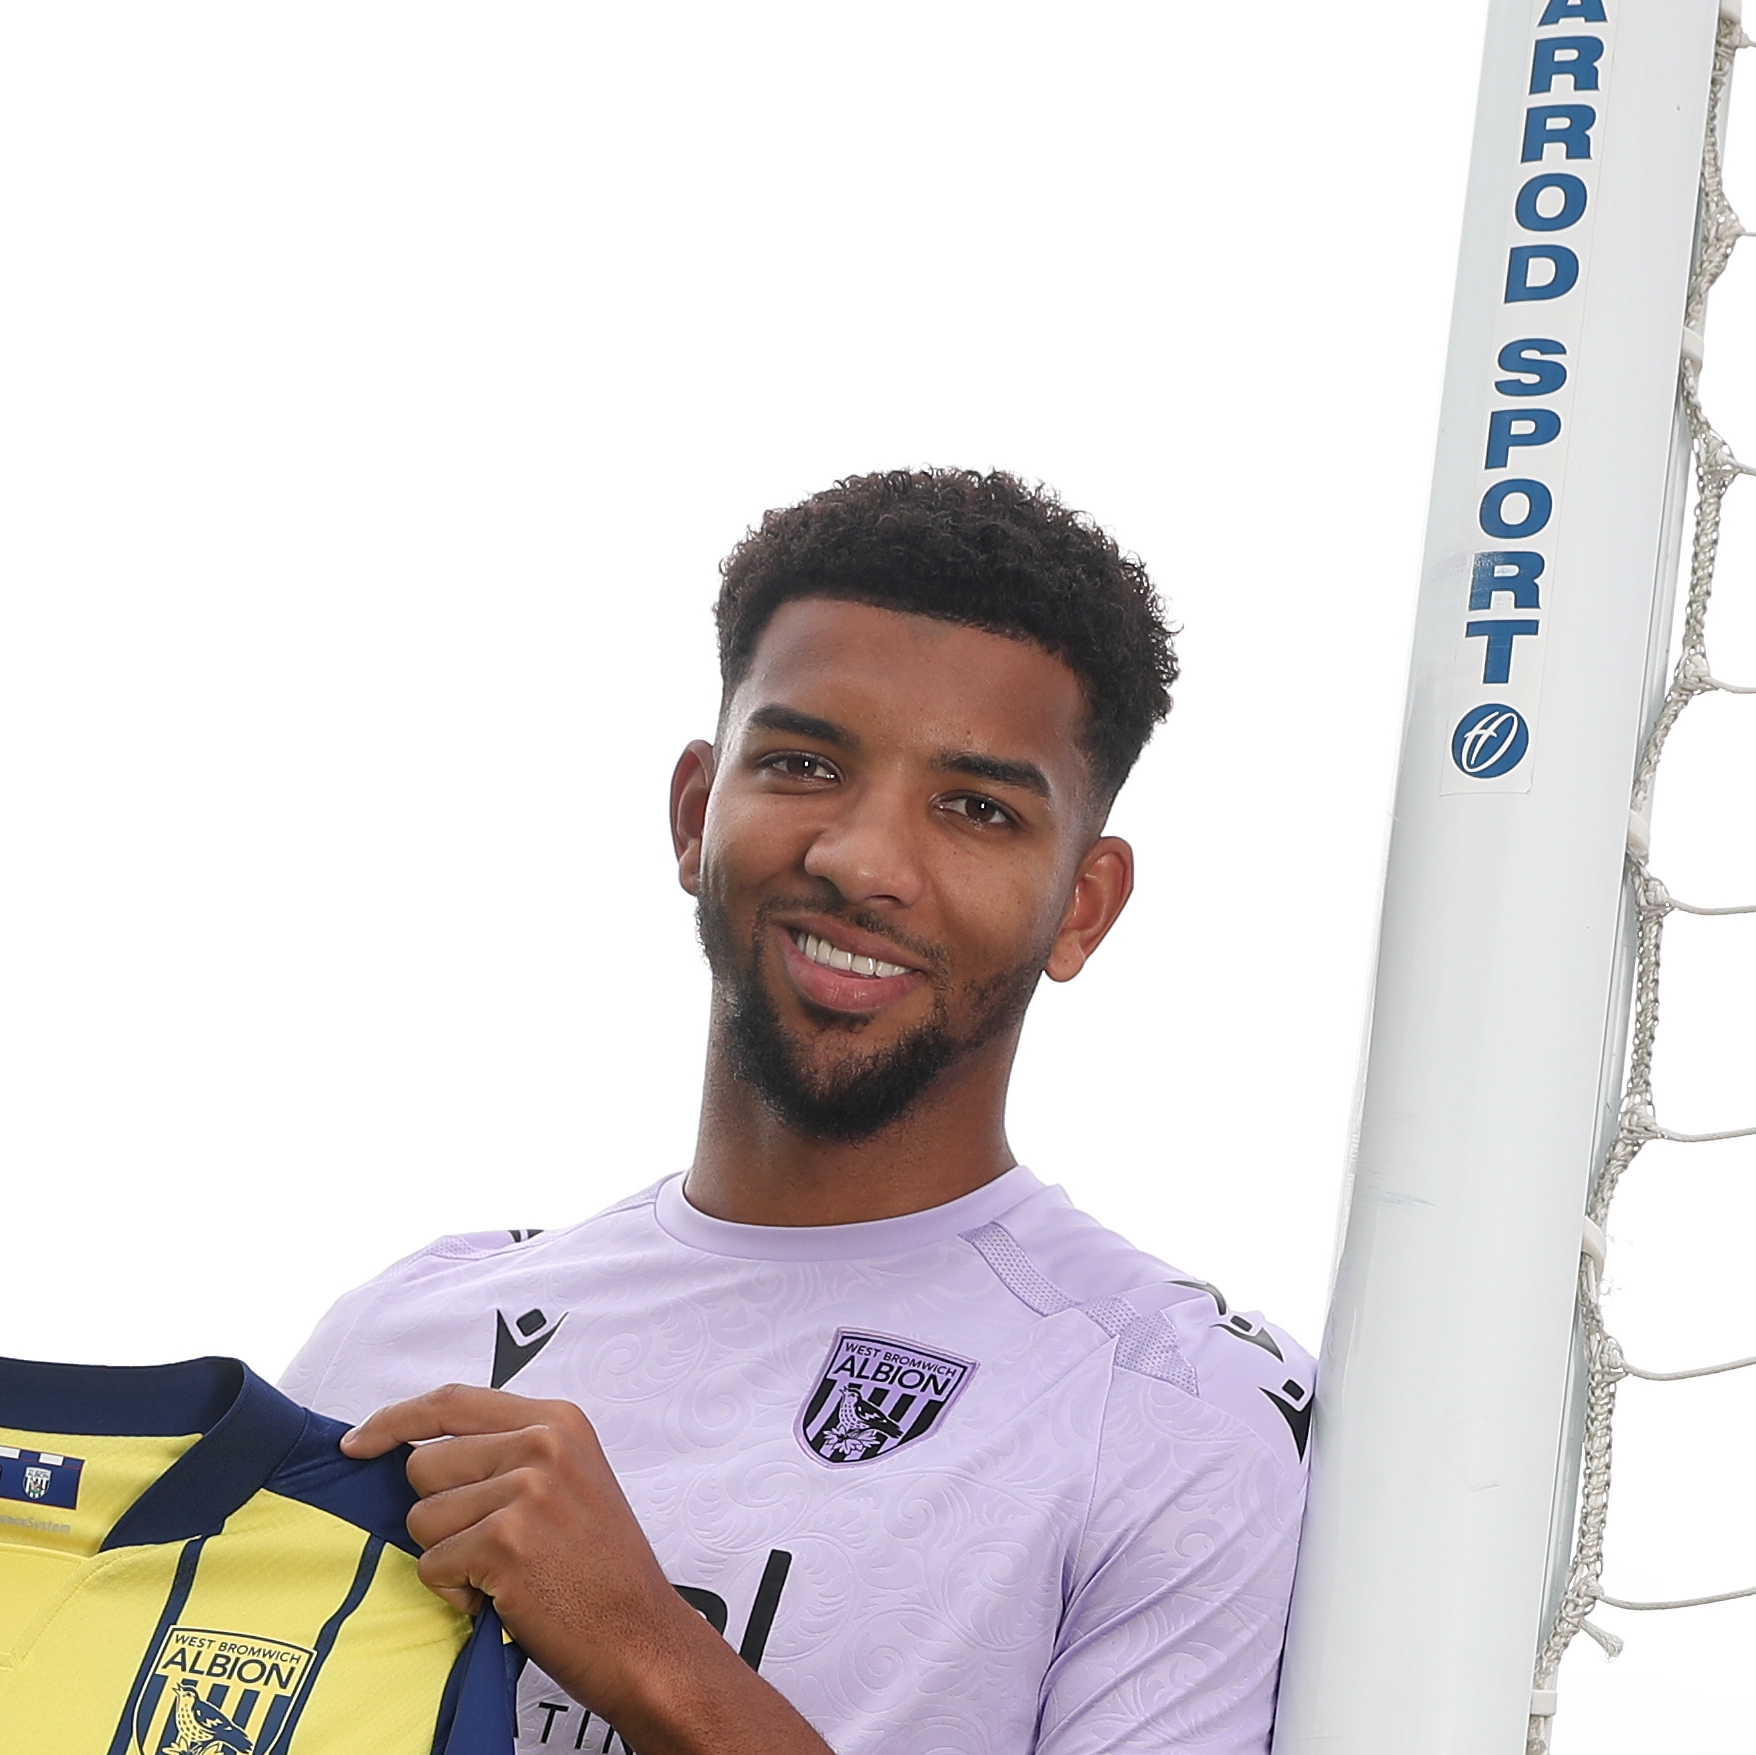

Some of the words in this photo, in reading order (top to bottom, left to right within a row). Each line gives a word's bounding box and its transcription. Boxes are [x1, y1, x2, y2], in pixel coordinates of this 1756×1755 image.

[1465, 338, 1567, 685] SPORT
[833, 1355, 951, 1395] ALBION
[846, 1342, 881, 1357] WEST
[883, 1352, 957, 1377] BROMWICH
[161, 1647, 296, 1690] ALBION
[175, 1633, 216, 1650] WEST
[218, 1641, 302, 1665] BROMWICH
